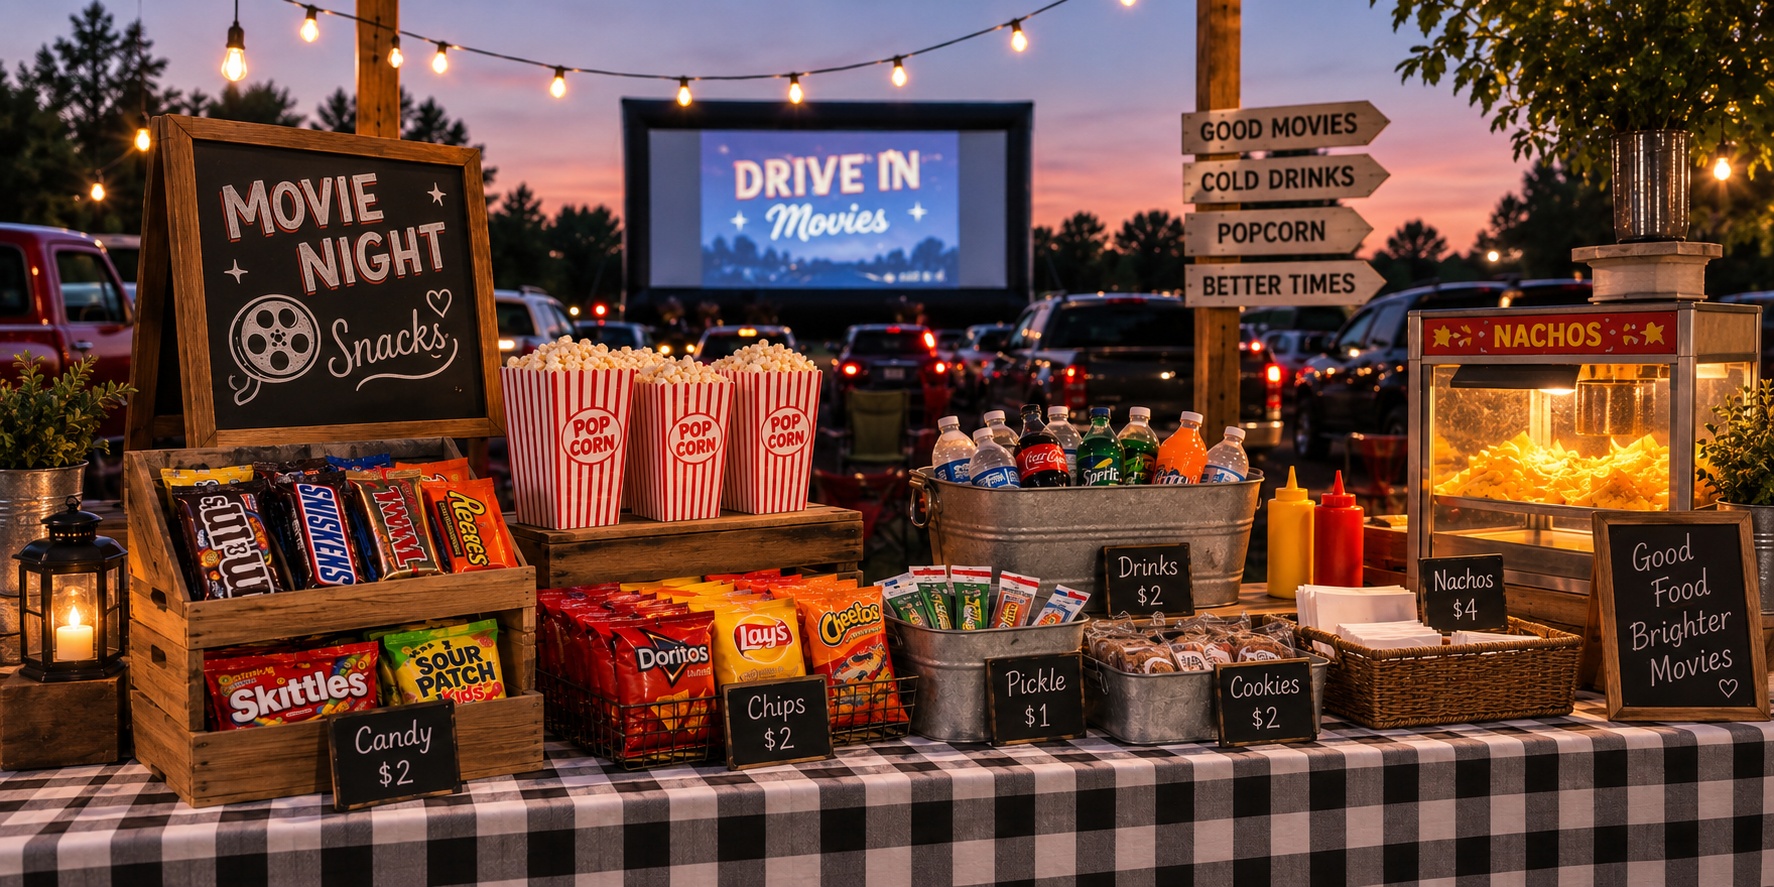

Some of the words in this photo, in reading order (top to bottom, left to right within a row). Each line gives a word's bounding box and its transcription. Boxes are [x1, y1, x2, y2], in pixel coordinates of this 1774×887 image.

[1201, 119, 1262, 142] GOOD
[1271, 112, 1357, 138] MOVIES
[733, 153, 865, 200] DRIVE
[878, 149, 921, 191] IN
[1201, 170, 1259, 192] COLD
[1269, 165, 1355, 189] DRINKS
[219, 172, 384, 242] MOVIE
[765, 202, 890, 242] Movies
[1217, 220, 1326, 244] POPCORN
[296, 221, 446, 296] NIGHT
[1202, 275, 1281, 296] BETTER
[1289, 273, 1355, 295] TIMES
[328, 308, 447, 378] Snacks
[1494, 320, 1602, 348] NACHOS
[572, 415, 611, 438] POP
[678, 420, 712, 440] POP
[770, 413, 802, 433] POP
[569, 434, 615, 456] CORN
[675, 437, 717, 457] CORN
[768, 430, 805, 449] CORN
[1118, 554, 1178, 578] Drinks
[1632, 532, 1694, 572] Good
[1434, 567, 1494, 592] Nachos
[1650, 567, 1711, 608] Food
[1137, 585, 1163, 606] $2
[1453, 598, 1478, 621] $4
[739, 619, 789, 650] Lay's
[820, 601, 881, 645] Cheetos
[1629, 609, 1732, 652] Brighter
[415, 645, 483, 675] SOUR
[637, 645, 709, 670] Doritos
[1651, 648, 1733, 687] Movies
[415, 661, 496, 698] PATCH
[1005, 667, 1066, 697] Pickle
[1230, 673, 1300, 699] Cookies
[230, 671, 368, 723] Skittles
[747, 693, 806, 722] Chips
[1025, 703, 1050, 728] $1
[1252, 706, 1280, 730] $2
[355, 719, 432, 754] Candy
[764, 726, 795, 752] $2
[378, 760, 414, 788] $2
